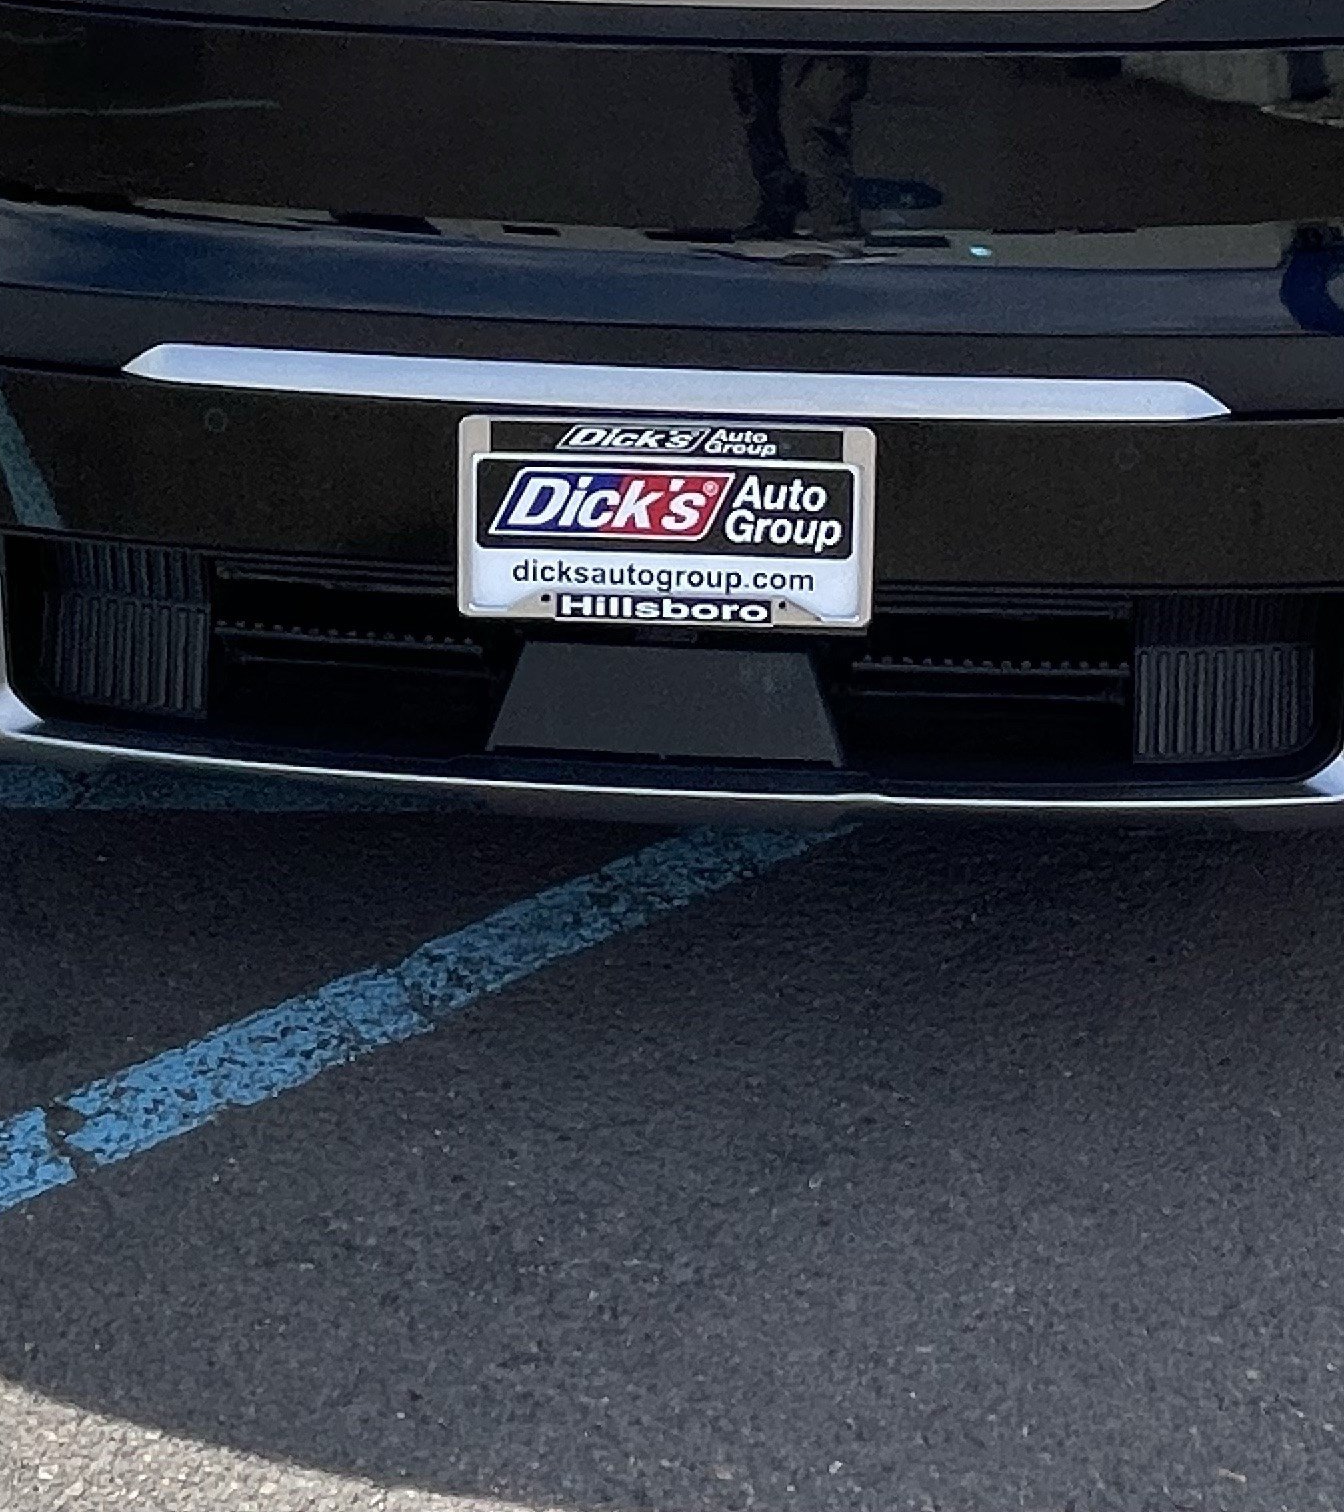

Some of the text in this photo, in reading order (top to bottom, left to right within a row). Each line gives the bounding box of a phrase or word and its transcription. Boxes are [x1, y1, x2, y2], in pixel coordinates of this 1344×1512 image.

[567, 428, 696, 449] Dick's
[705, 441, 776, 457] Group
[711, 429, 768, 443] Auto
[506, 475, 706, 532] Dick's
[733, 475, 827, 512] Auto
[725, 509, 842, 553] Group
[513, 560, 814, 594] dicksautogroup.com
[560, 594, 768, 621] Hillsboro
